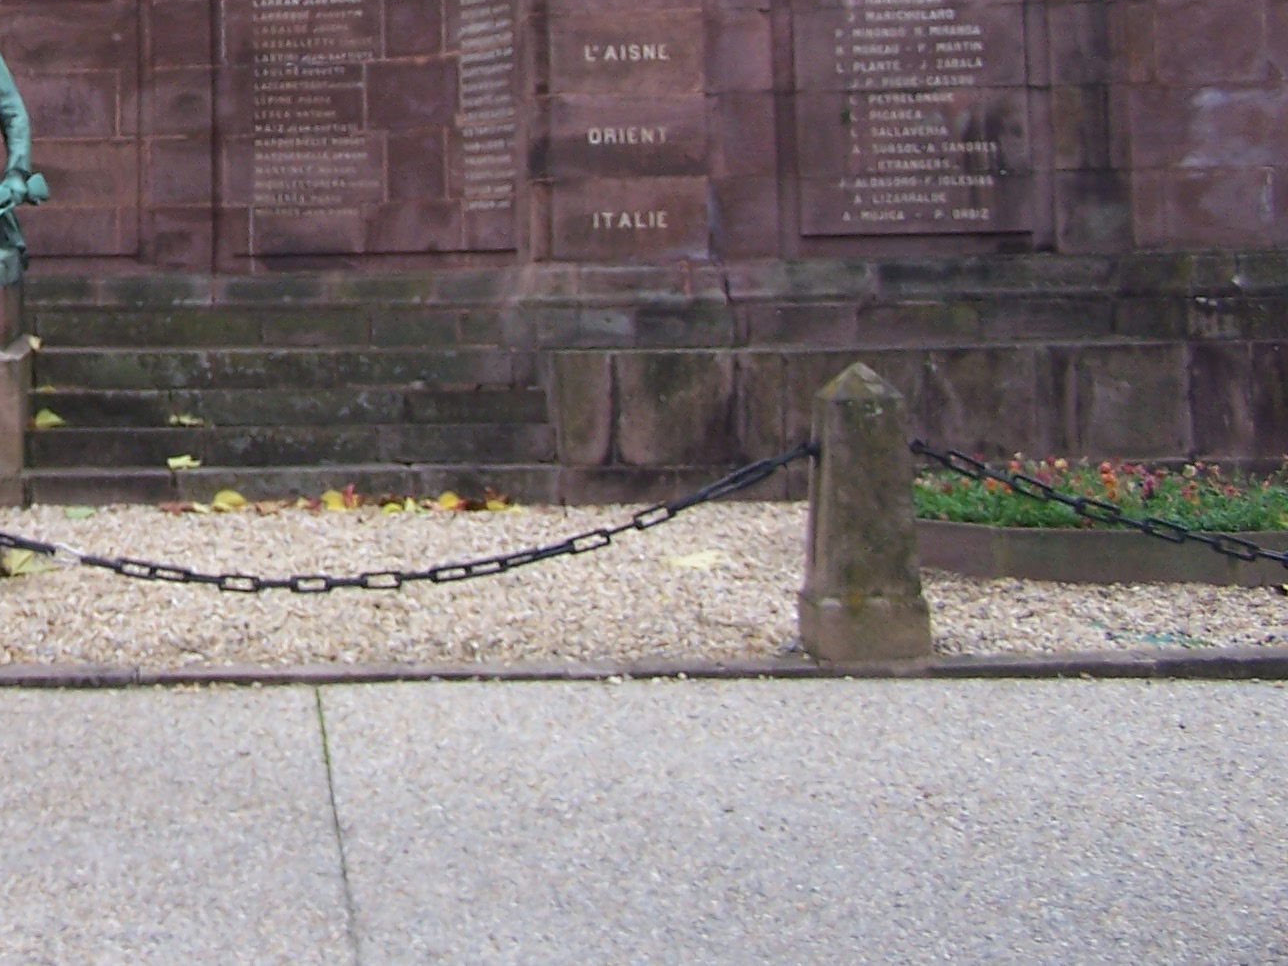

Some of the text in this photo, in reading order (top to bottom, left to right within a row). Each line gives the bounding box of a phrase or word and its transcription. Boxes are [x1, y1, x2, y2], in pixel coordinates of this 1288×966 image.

[584, 43, 671, 62] L'AISNE
[586, 126, 668, 145] ORIENT
[592, 210, 668, 229] ITALIE
